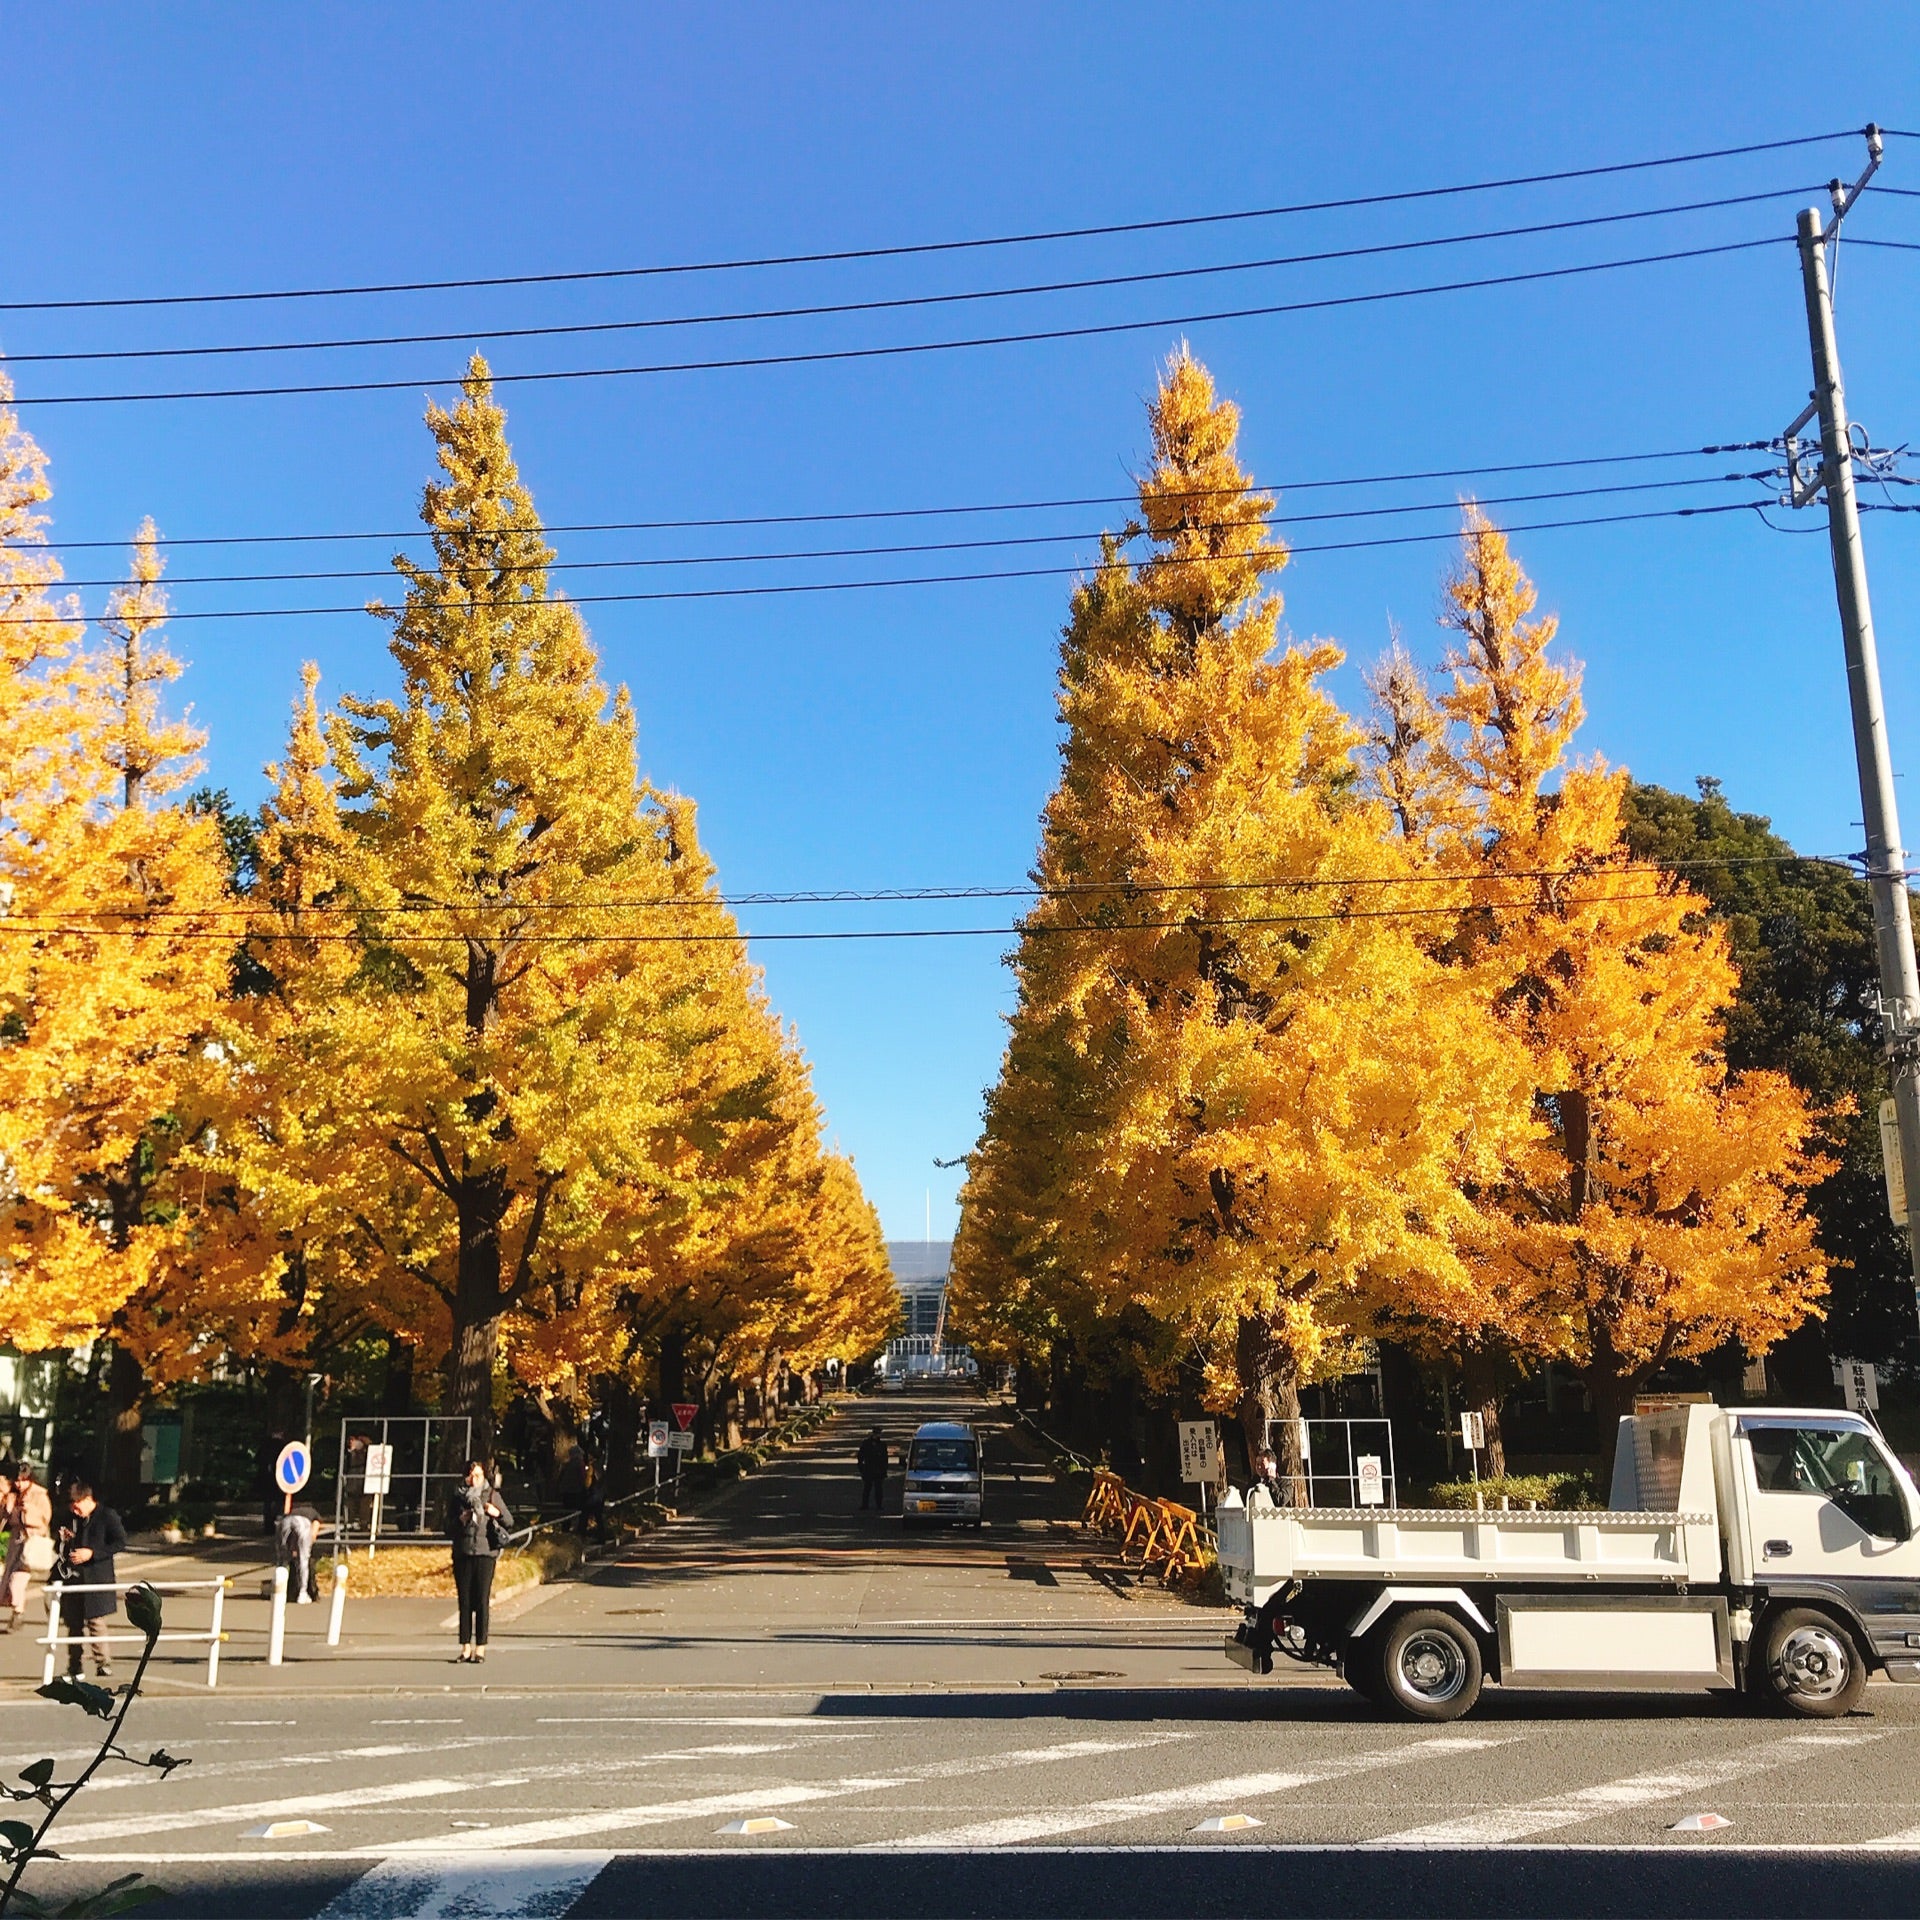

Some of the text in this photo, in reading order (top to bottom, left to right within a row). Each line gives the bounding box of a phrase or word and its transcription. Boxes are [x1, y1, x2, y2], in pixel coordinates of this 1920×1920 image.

[1852, 1365, 1868, 1409] 駐輪禁止
[1182, 1439, 1193, 1477] 出来ません
